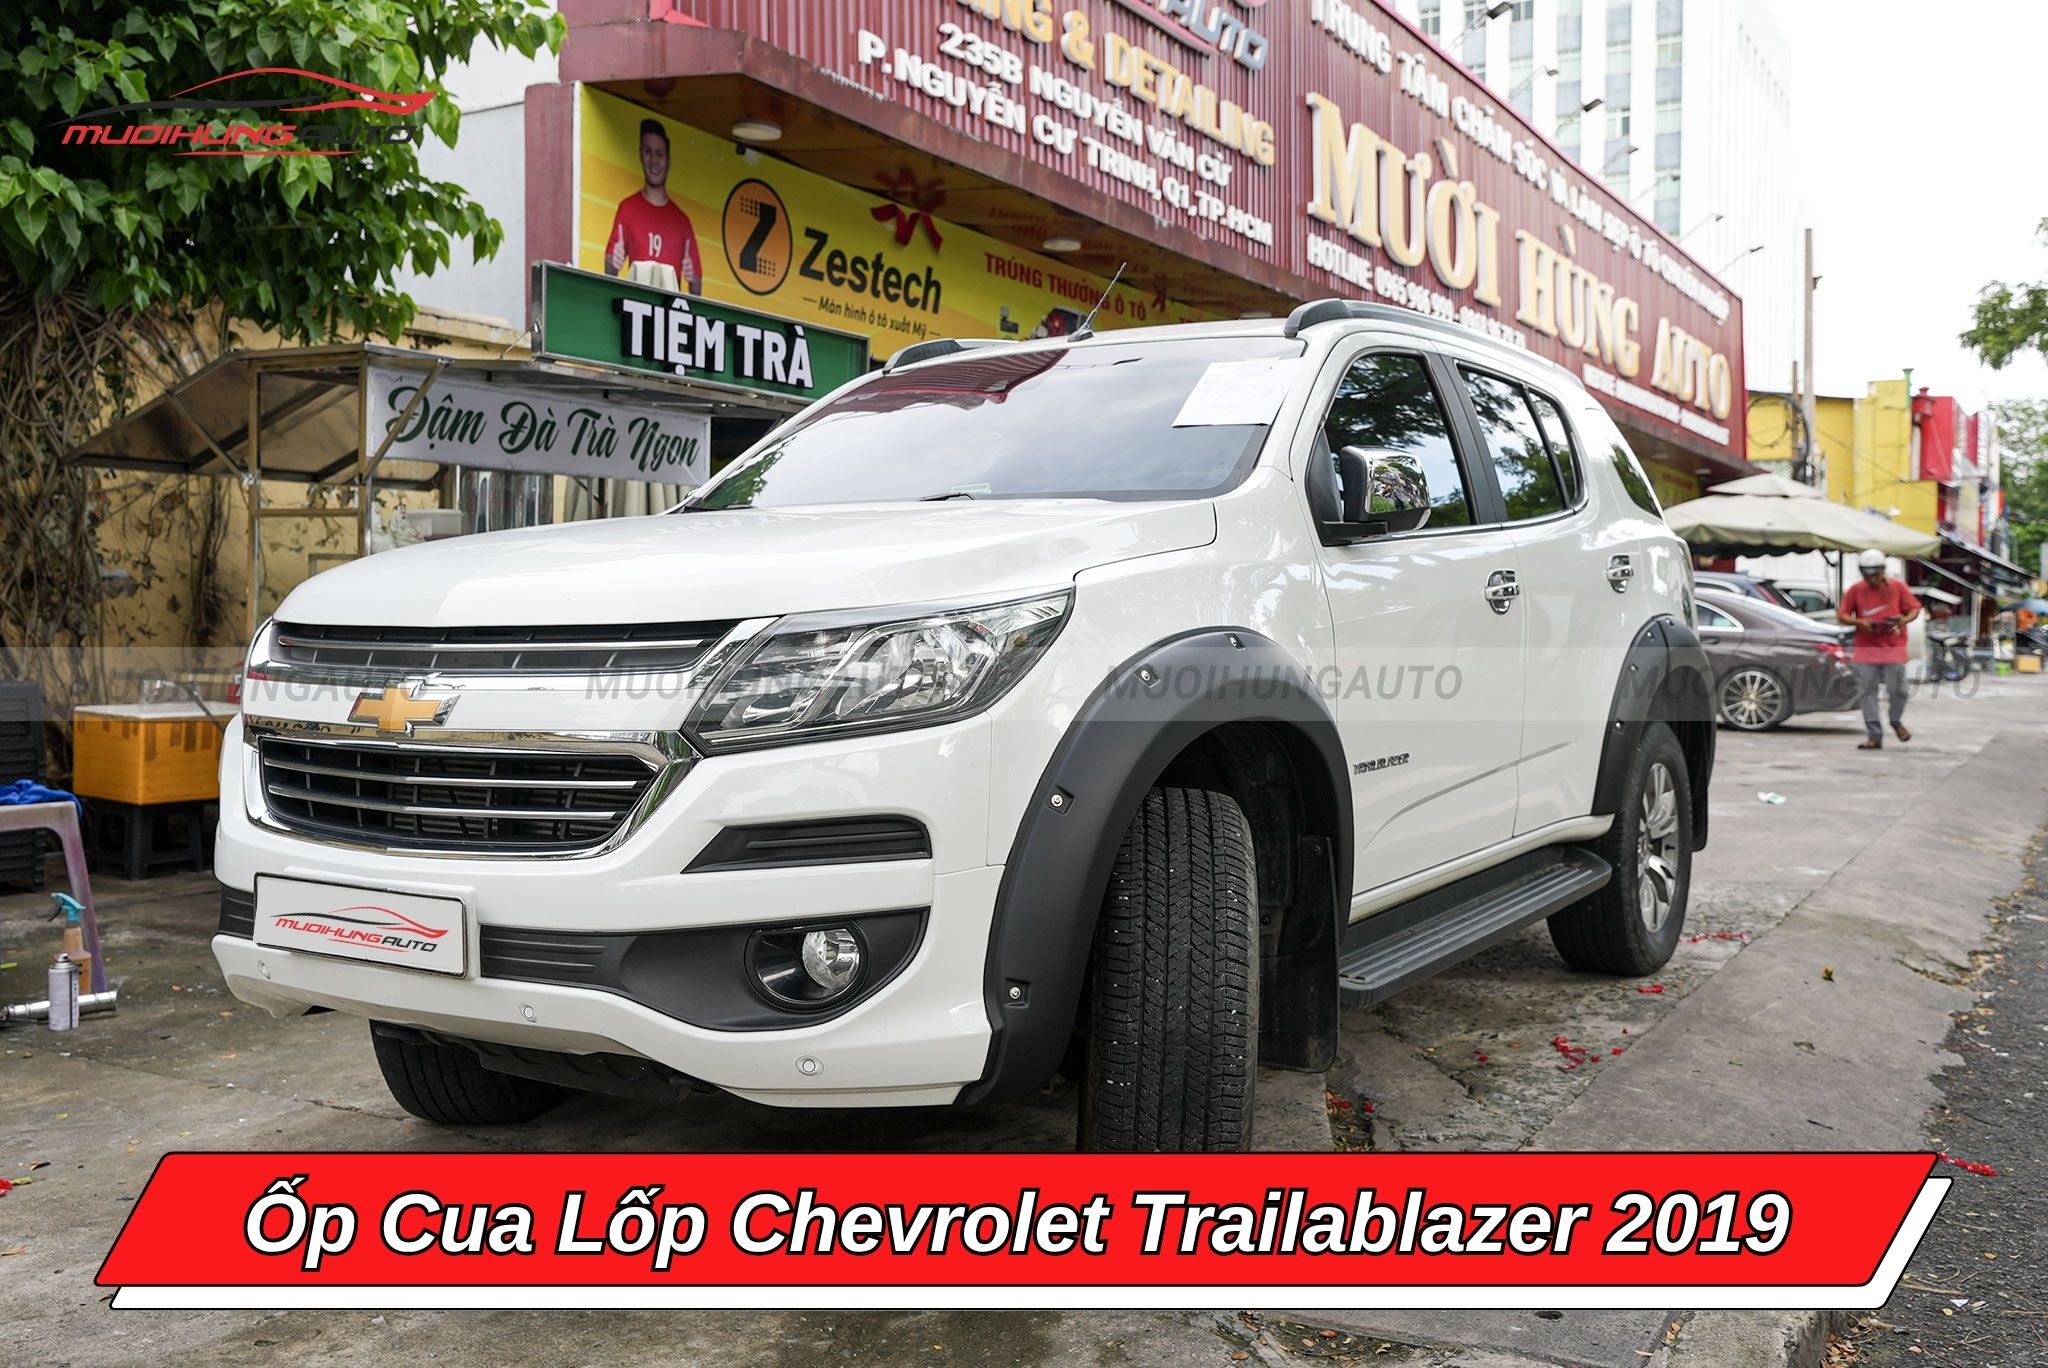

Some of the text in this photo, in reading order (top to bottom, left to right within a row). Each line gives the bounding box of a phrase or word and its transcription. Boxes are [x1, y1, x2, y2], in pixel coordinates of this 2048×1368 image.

[937, 22, 1233, 187] 235B NGUYỄN VĂN CỪ
[1060, 10, 1096, 70] &
[1104, 31, 1276, 166] DETAILING
[1396, 50, 1448, 118] TÂM
[1451, 96, 1512, 164] CHĂM
[1513, 139, 1548, 190] SÓC
[1032, 114, 1078, 154] CƯ
[648, 232, 662, 258] 19
[799, 226, 942, 315] Zestech
[984, 252, 1042, 289] TRÚNG
[1115, 293, 1125, 315] Ô
[1129, 300, 1146, 321] TÔ
[1306, 91, 1501, 308] MƯỜI
[1515, 223, 1642, 378] HÙNG
[1650, 316, 1732, 420] AUTO
[622, 297, 814, 389] TIỆM TRÀ
[818, 295, 842, 315] Màn
[844, 303, 867, 323] hình
[868, 312, 876, 325] ô
[877, 312, 889, 328] tô
[386, 386, 699, 473] Đậm Đà Trà Ngon
